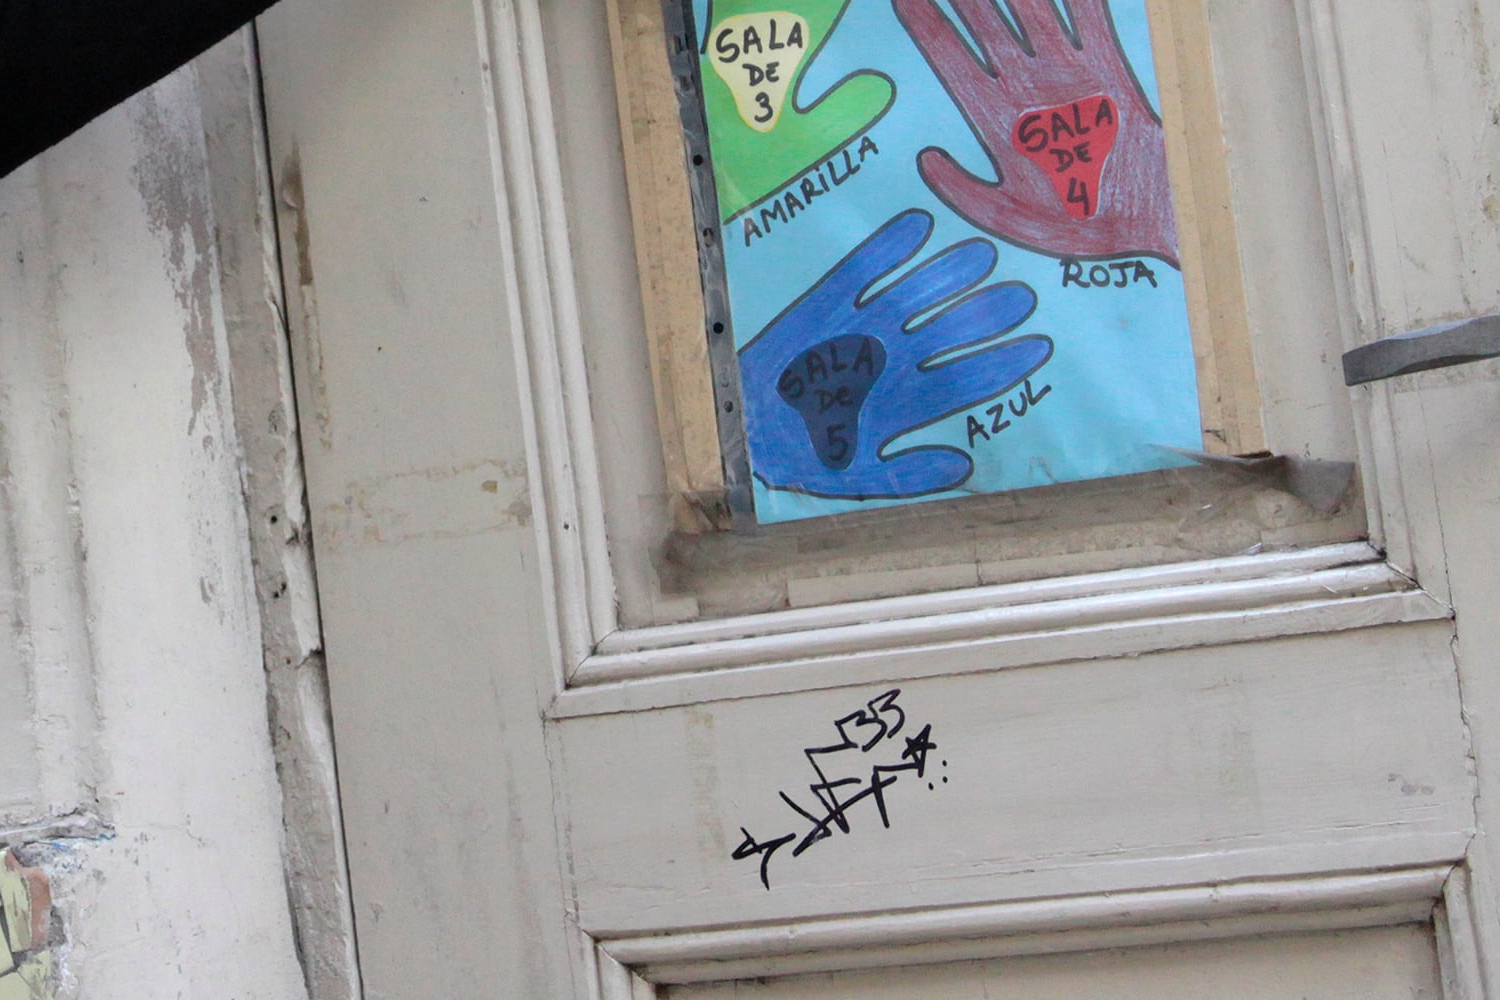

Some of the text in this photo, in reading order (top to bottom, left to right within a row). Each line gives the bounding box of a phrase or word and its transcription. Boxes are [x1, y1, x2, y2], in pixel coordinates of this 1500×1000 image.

[715, 18, 803, 63] SALA
[742, 61, 780, 87] DE
[754, 91, 774, 123] 3
[1018, 98, 1114, 152] SALA
[1050, 141, 1092, 172] DE
[1067, 177, 1090, 216] 4
[1059, 257, 1158, 289] ROJA
[779, 338, 874, 399] SALA
[966, 379, 1052, 449] AZUL
[827, 423, 849, 461] 5
